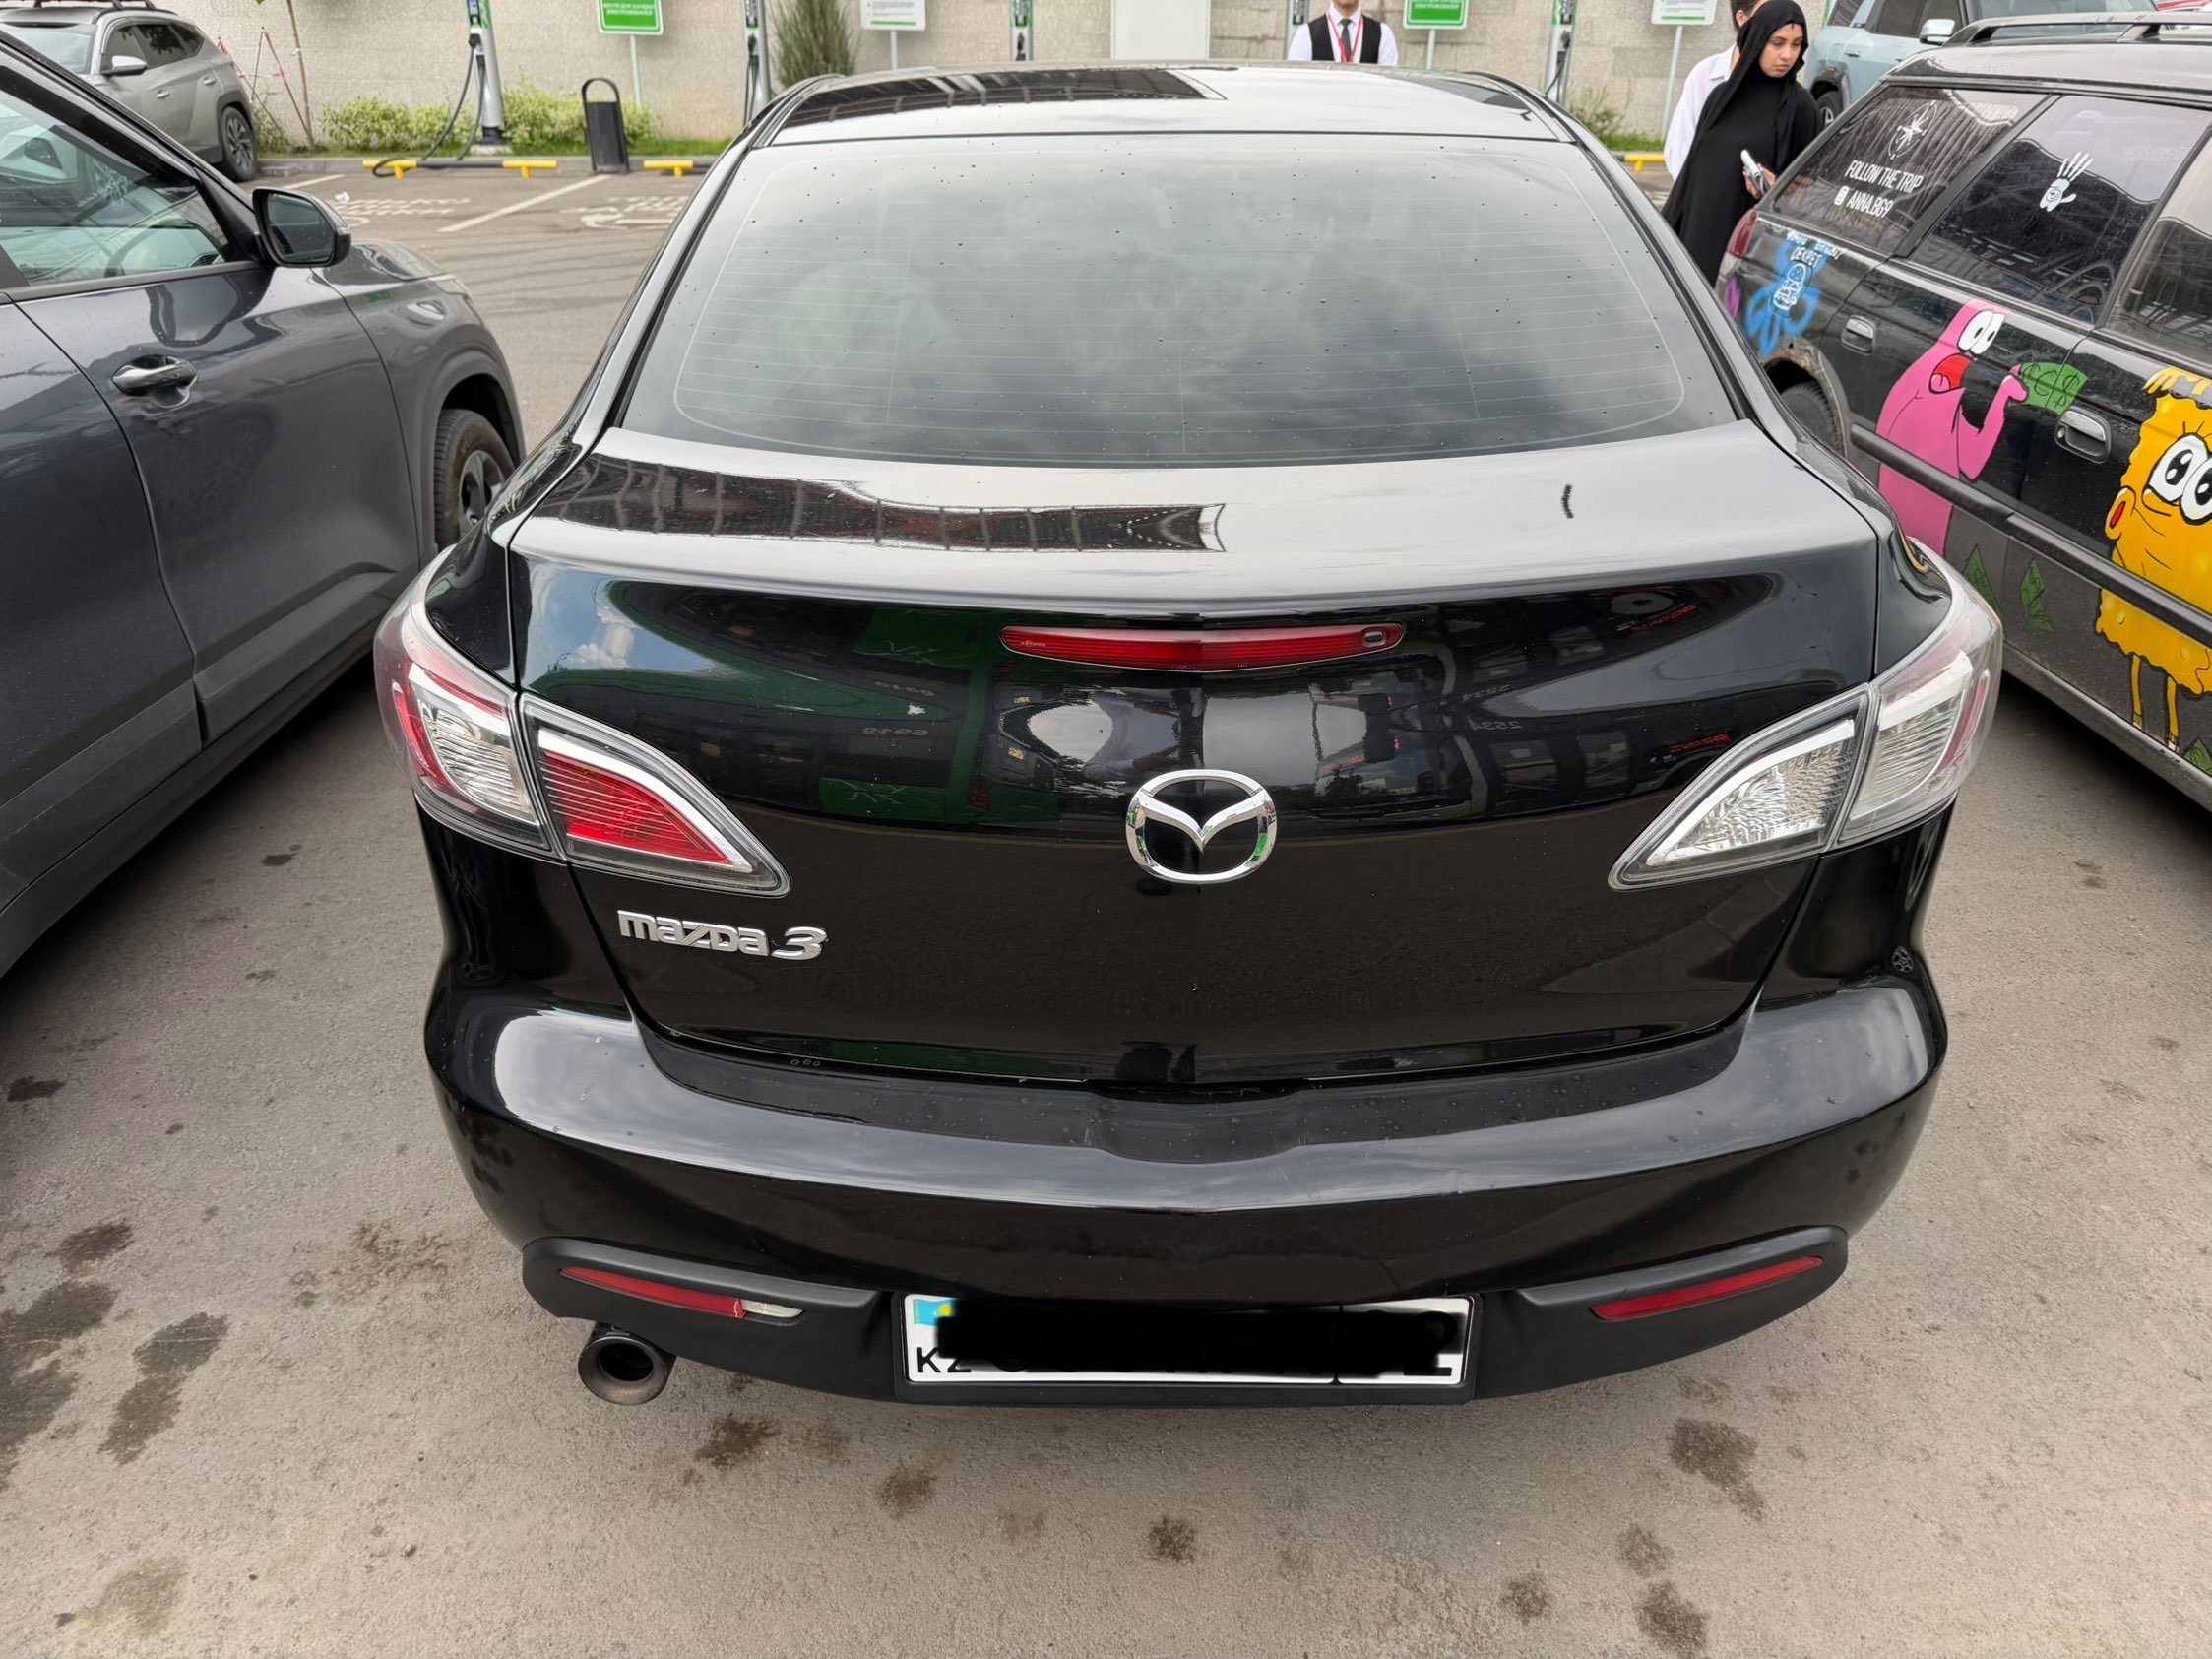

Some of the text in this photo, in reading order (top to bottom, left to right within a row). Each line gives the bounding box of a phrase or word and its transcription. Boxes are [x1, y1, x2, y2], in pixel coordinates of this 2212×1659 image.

[1844, 160, 1925, 194] FOLLOW THE TRIP
[771, 925, 828, 961] 3
